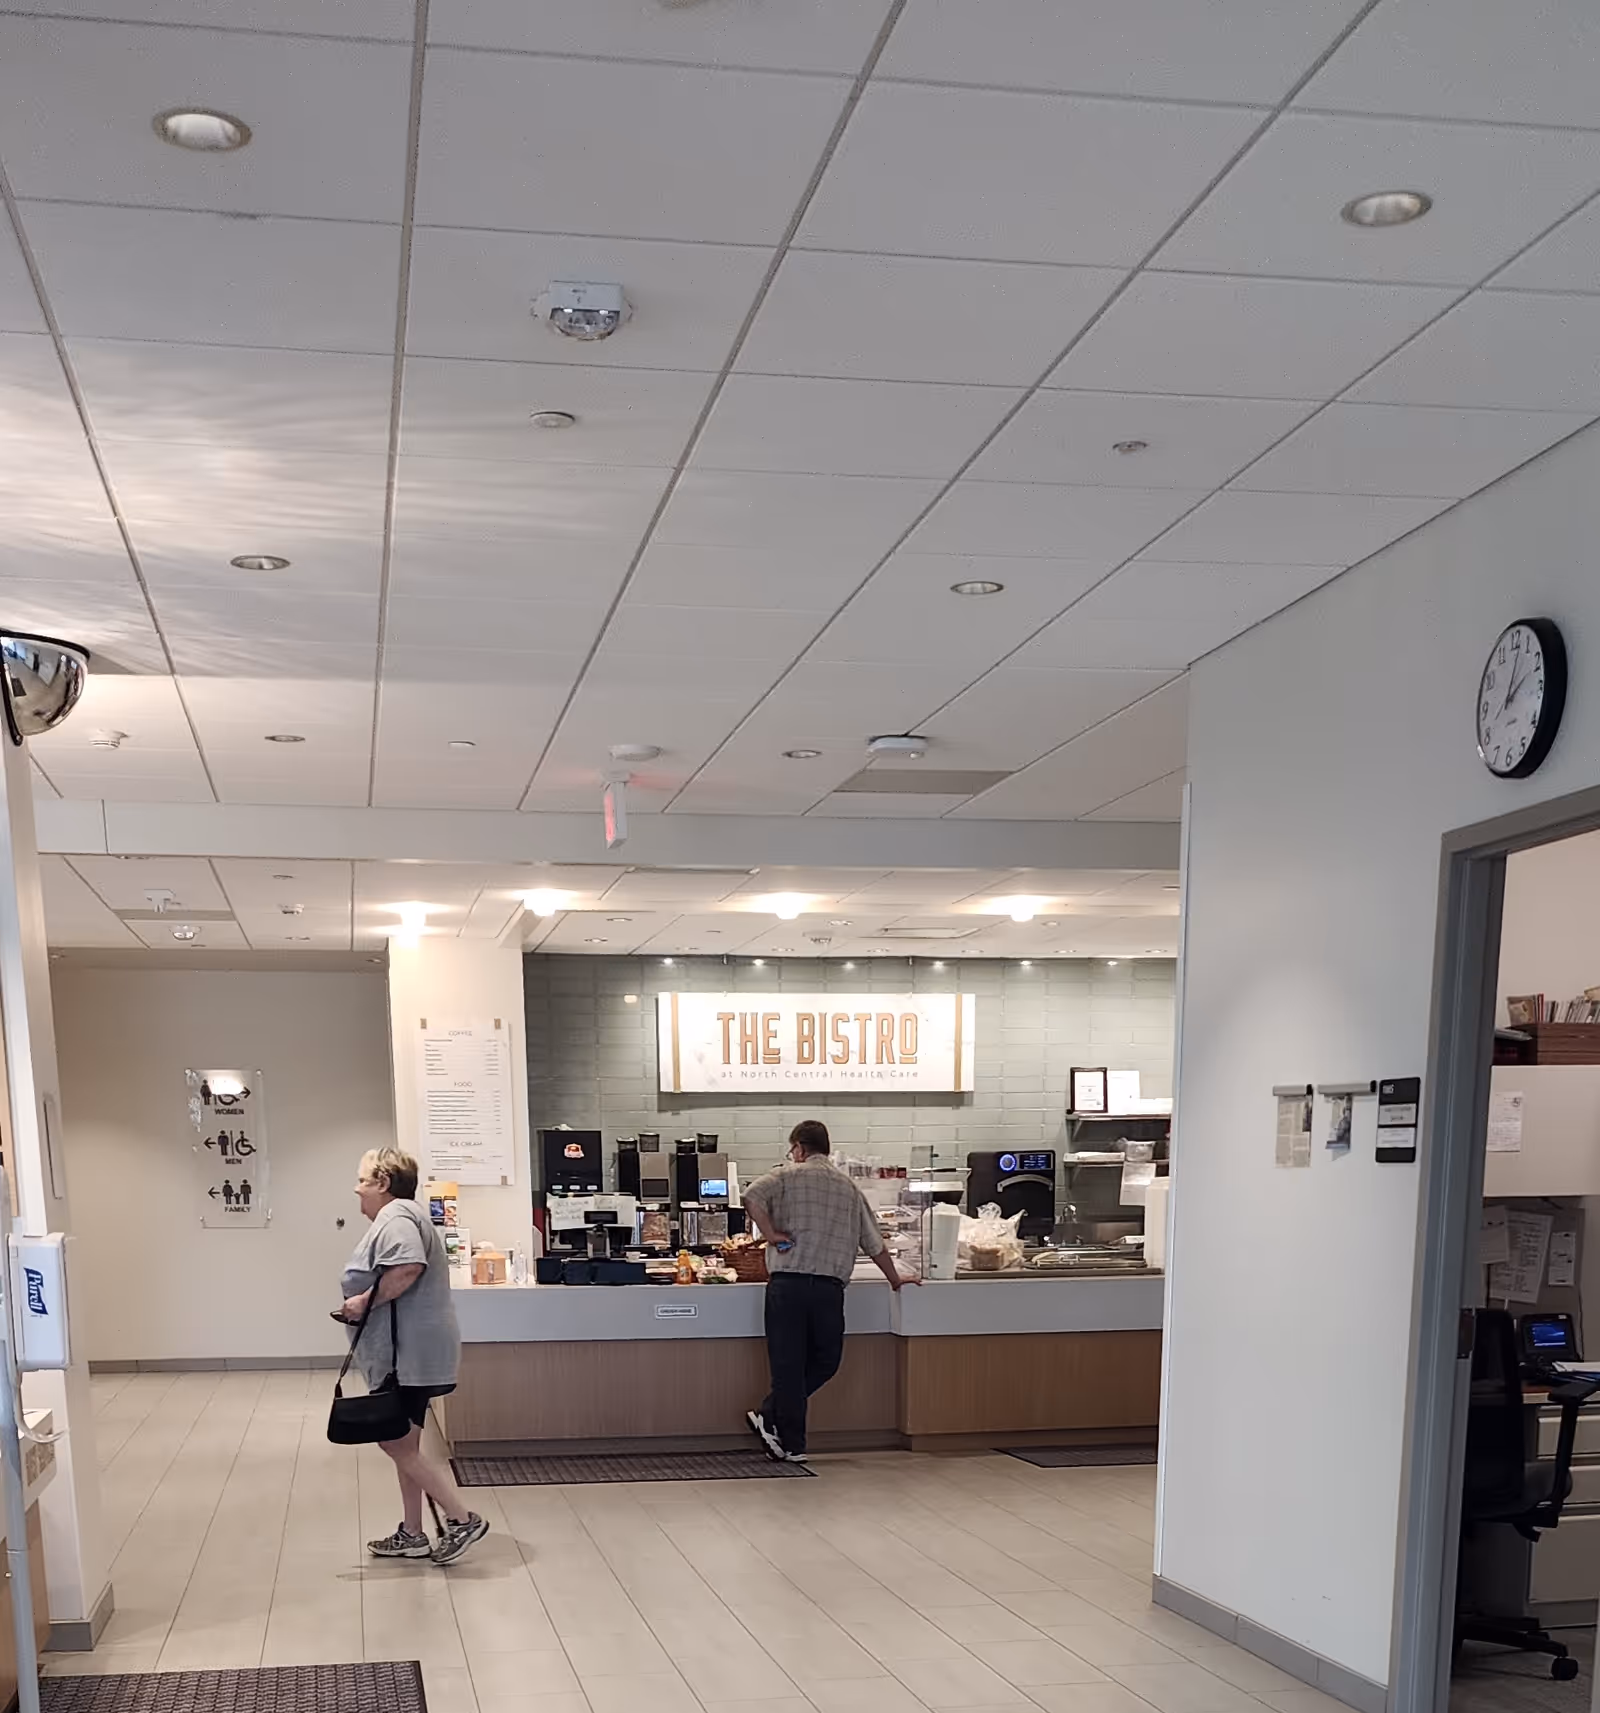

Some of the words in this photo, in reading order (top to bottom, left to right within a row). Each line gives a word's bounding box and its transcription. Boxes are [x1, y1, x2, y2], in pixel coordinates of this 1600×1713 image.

[1511, 629, 1521, 651] 12
[1525, 635, 1530, 654] 1
[1499, 647, 1506, 666] 11
[1534, 651, 1541, 672] 2
[1486, 670, 1496, 691] 10
[1482, 701, 1489, 721] 9
[1530, 710, 1538, 729] 4
[1484, 726, 1491, 746] 8
[1518, 736, 1526, 756] 5
[1493, 745, 1500, 765] 7
[1505, 746, 1513, 767] 6
[717, 1012, 781, 1065] THE
[796, 1012, 918, 1065] BISTRO
[890, 1070, 919, 1078] Care
